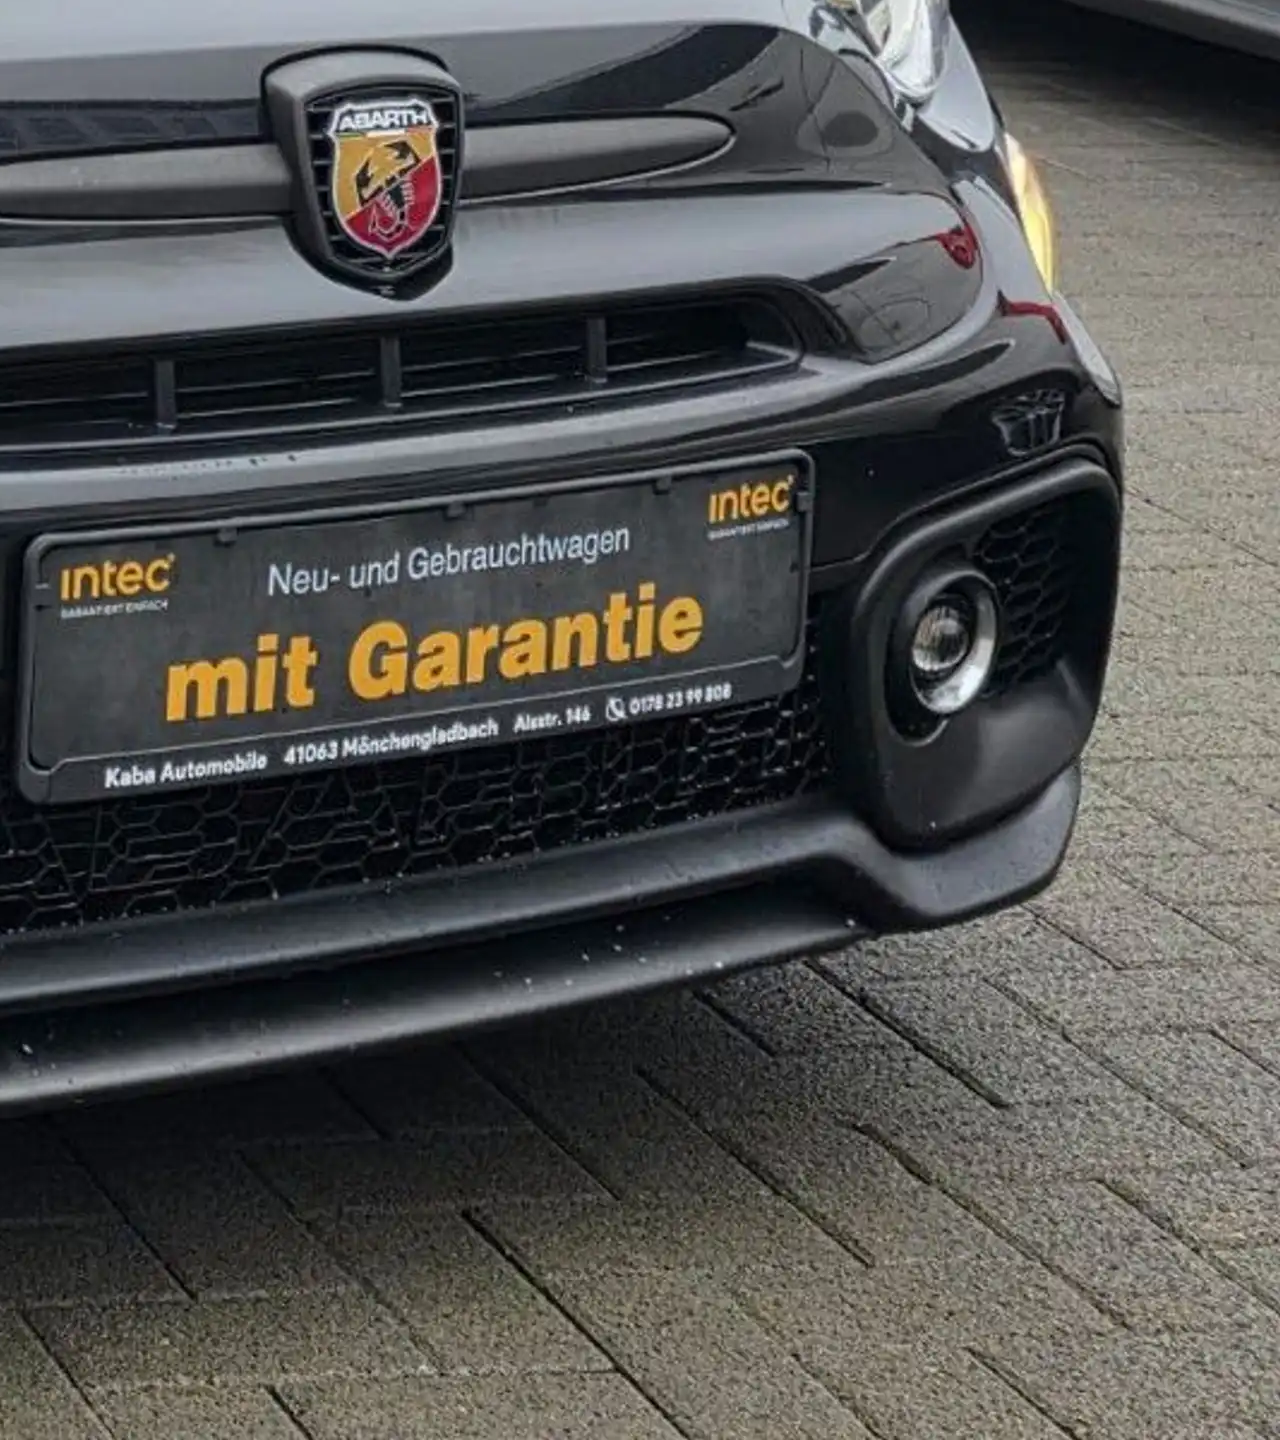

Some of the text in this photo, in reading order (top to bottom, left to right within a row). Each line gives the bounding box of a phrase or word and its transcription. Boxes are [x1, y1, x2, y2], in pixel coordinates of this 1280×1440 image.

[340, 110, 428, 130] ABARTH
[709, 481, 789, 524] intec
[60, 558, 171, 601] intec
[268, 527, 630, 597] Neu- und Gebrauchtwagen
[165, 582, 704, 722] mit Garantie
[104, 766, 156, 790] Kaba
[160, 750, 268, 783] Automobile
[283, 742, 338, 765] 41063
[342, 717, 500, 758] Mönchengladbach
